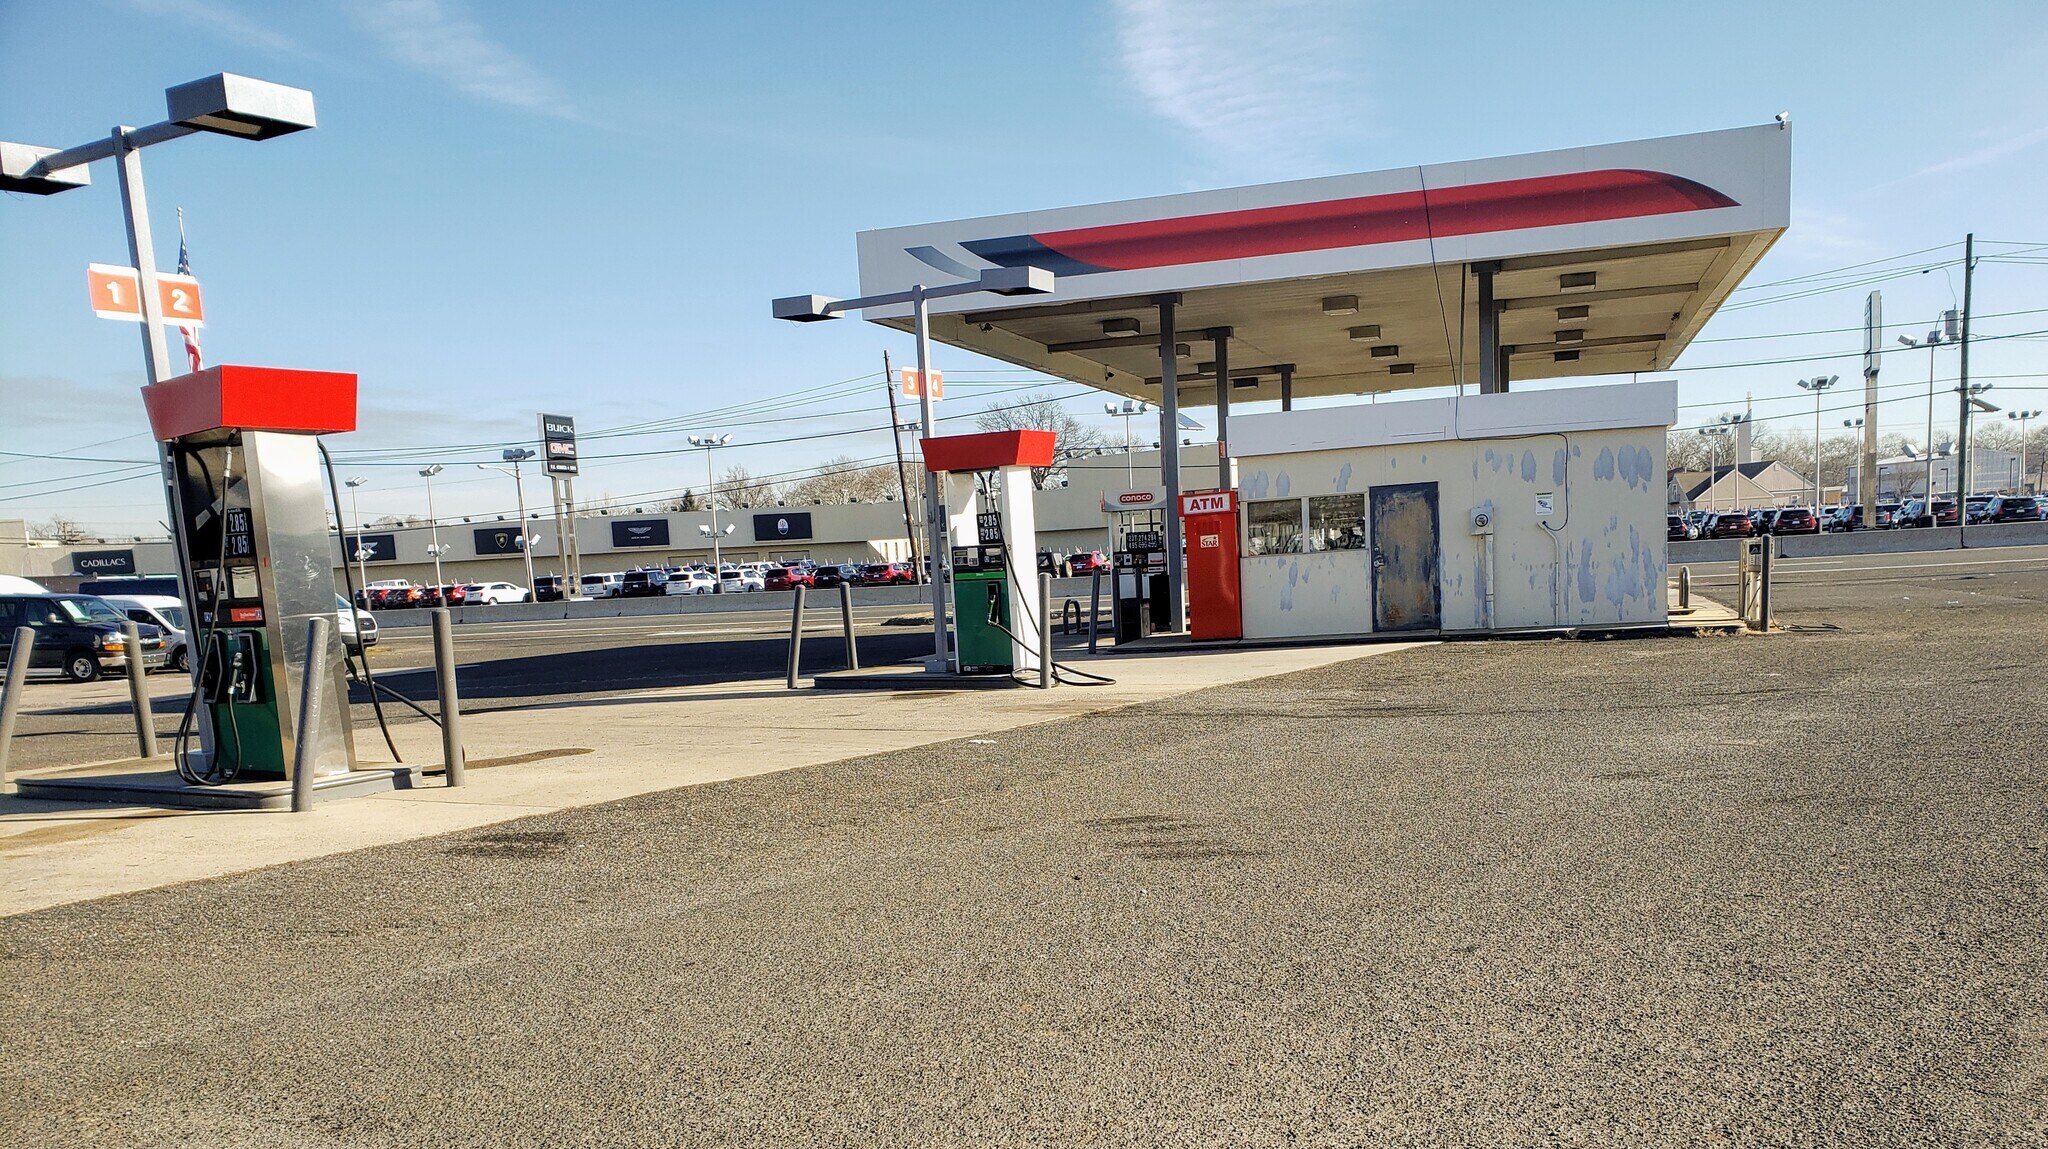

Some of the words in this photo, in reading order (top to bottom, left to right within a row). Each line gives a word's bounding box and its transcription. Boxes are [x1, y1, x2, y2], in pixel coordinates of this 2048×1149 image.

[106, 281, 121, 304] 1
[171, 288, 192, 314] 2
[907, 375, 915, 390] 3
[932, 379, 939, 392] 4
[546, 423, 574, 434] BUICK
[550, 442, 575, 455] GMC
[1189, 497, 1223, 511] ATM
[81, 558, 126, 568] CADILLACS
